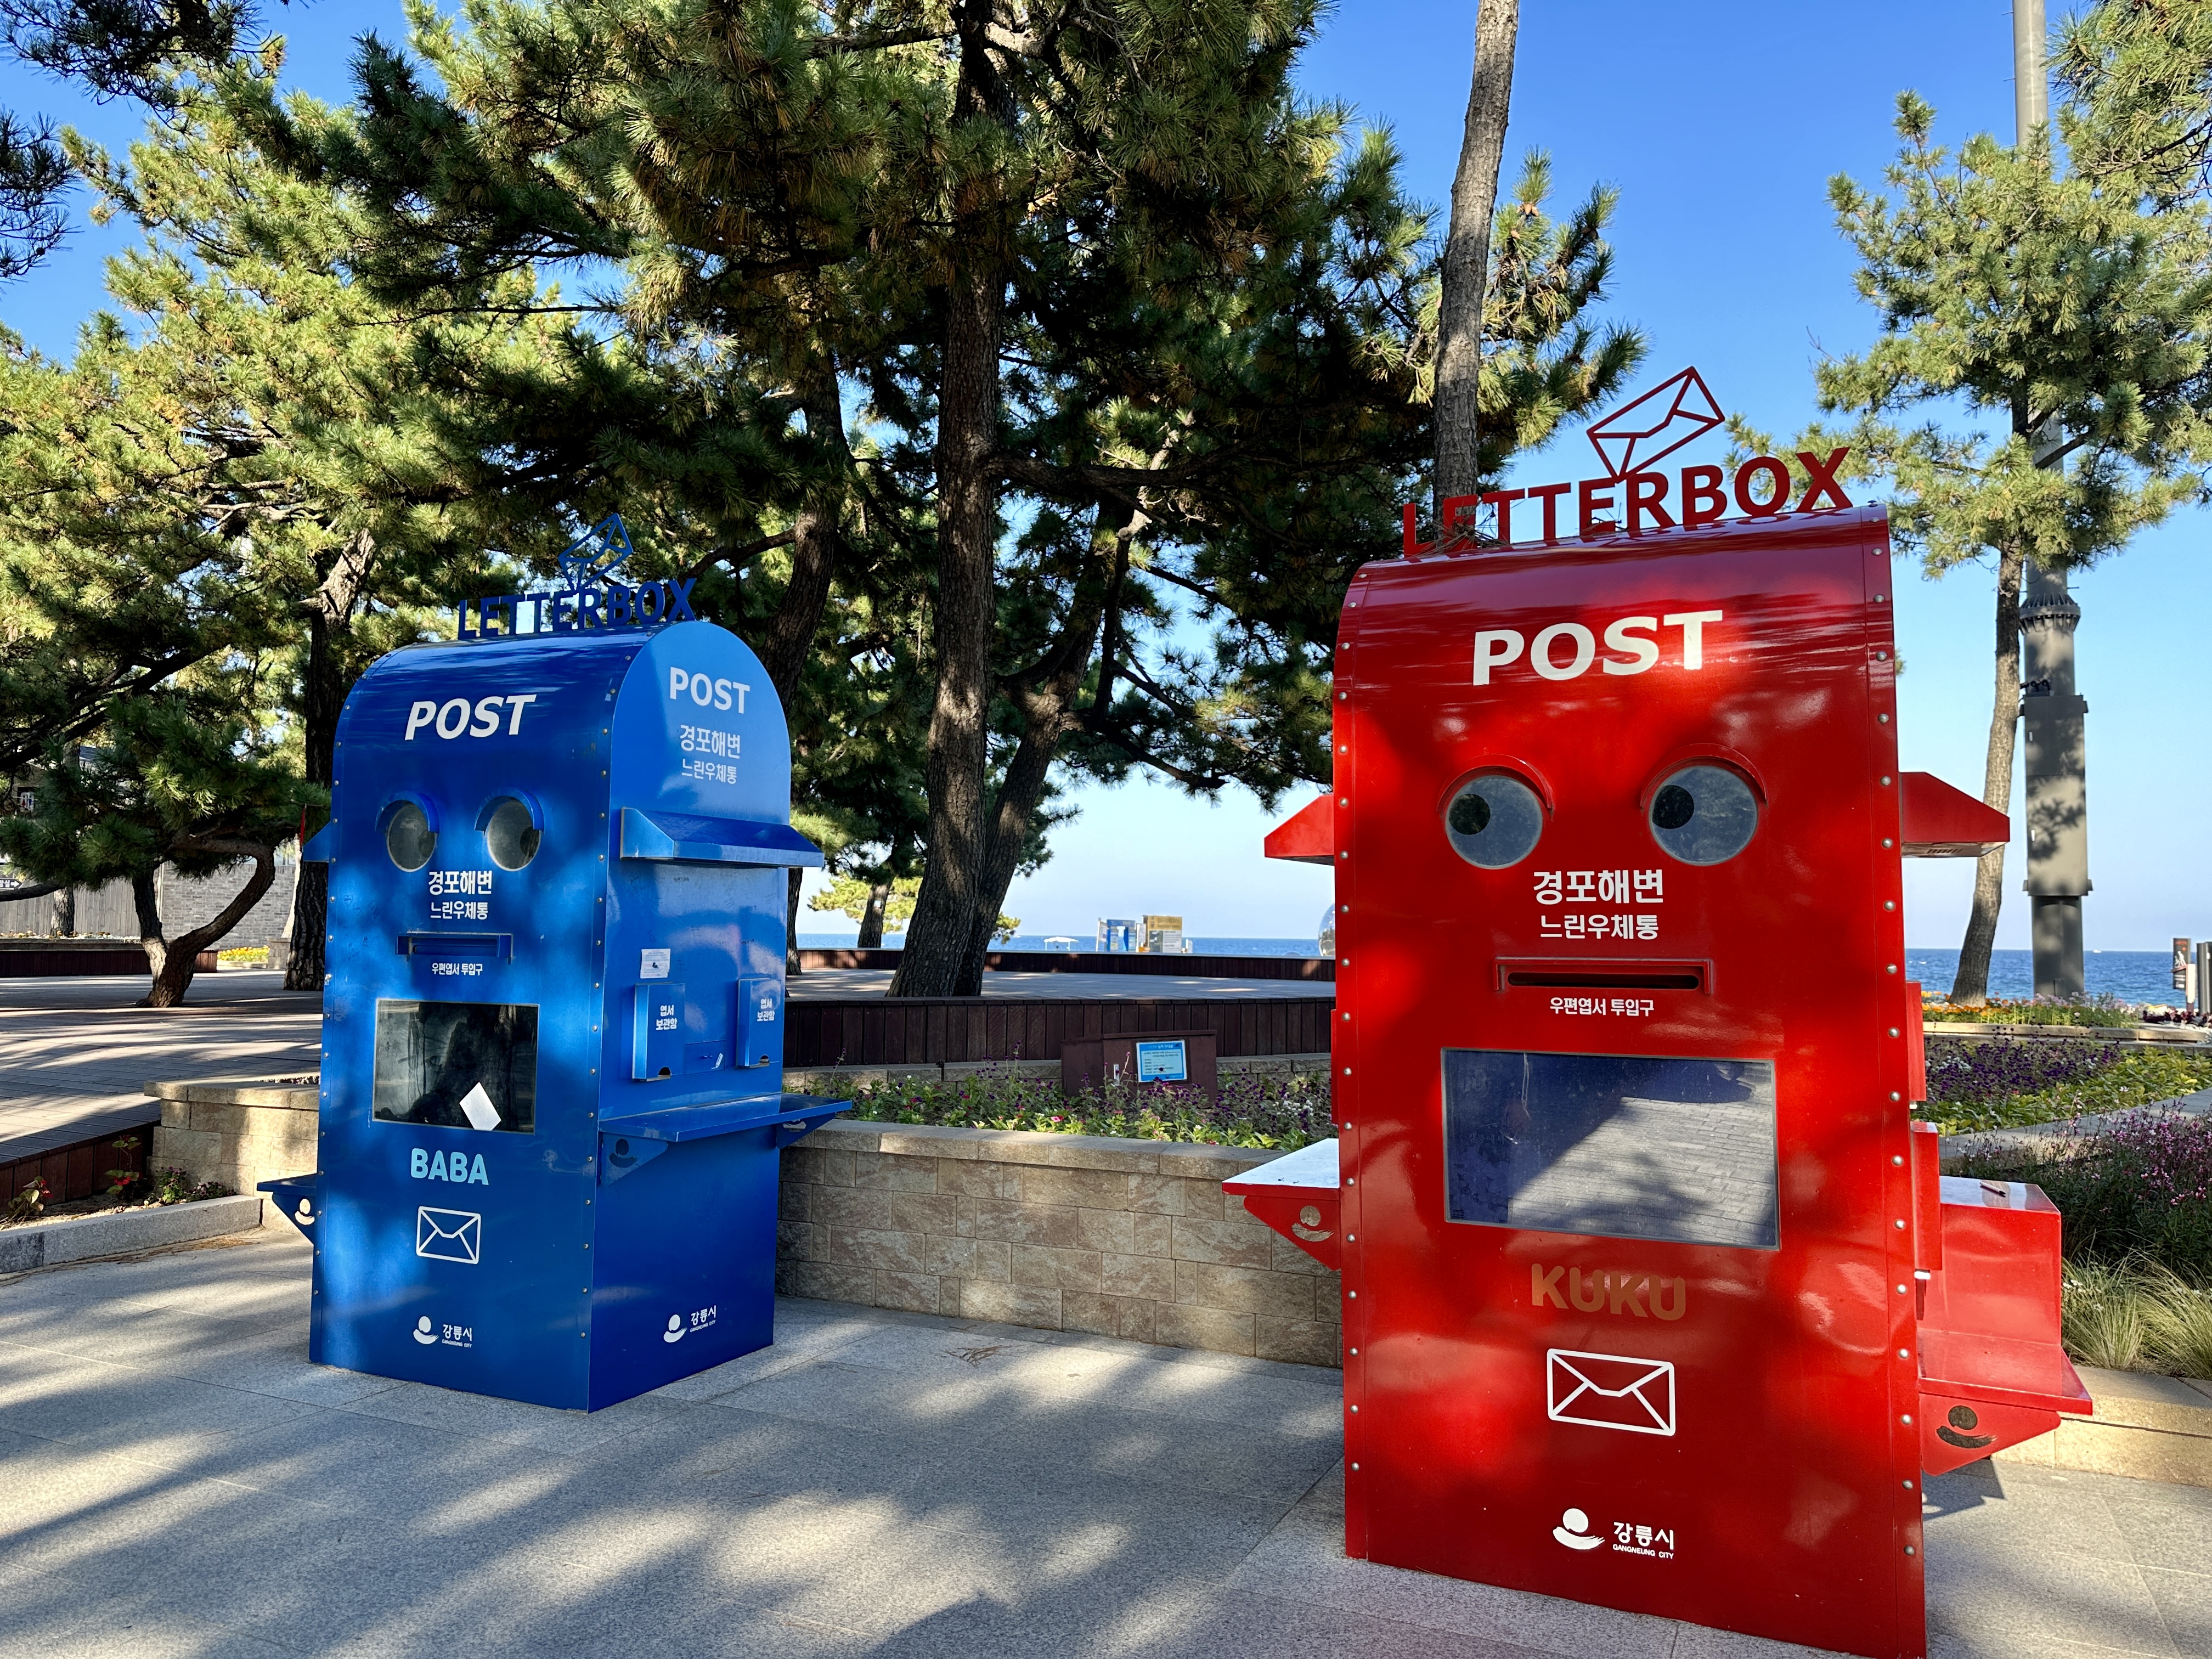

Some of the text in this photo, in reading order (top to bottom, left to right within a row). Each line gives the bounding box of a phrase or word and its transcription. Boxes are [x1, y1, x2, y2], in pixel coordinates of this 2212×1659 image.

[1403, 447, 1854, 558] LETTERBOX
[458, 578, 697, 640] LETTERBOX
[1472, 610, 1723, 686] POST
[670, 667, 751, 714] POST
[404, 694, 537, 741] POST
[680, 724, 741, 759] 경포해변
[681, 758, 737, 785] 느린우체통
[428, 870, 493, 895] 경포해변
[1533, 869, 1664, 905] 경포해변
[430, 900, 488, 920] 느린우체통
[1540, 914, 1659, 940] 느린우체통
[431, 962, 483, 977] 우편엽서 투입구
[659, 1004, 675, 1017] 엽서
[757, 1009, 776, 1023] 보관함
[760, 997, 773, 1010] 엽서
[1550, 997, 1655, 1017] 우편엽서 투입구
[656, 1018, 678, 1031] 보관함
[410, 1148, 489, 1186] BABA
[1531, 1263, 1686, 1321] KUKU
[691, 1305, 716, 1326] 강릉시
[443, 1324, 472, 1341] 강릉시
[1613, 1521, 1674, 1550] 강릉시
[1612, 1543, 1674, 1560] GANGNEUNG CITY
